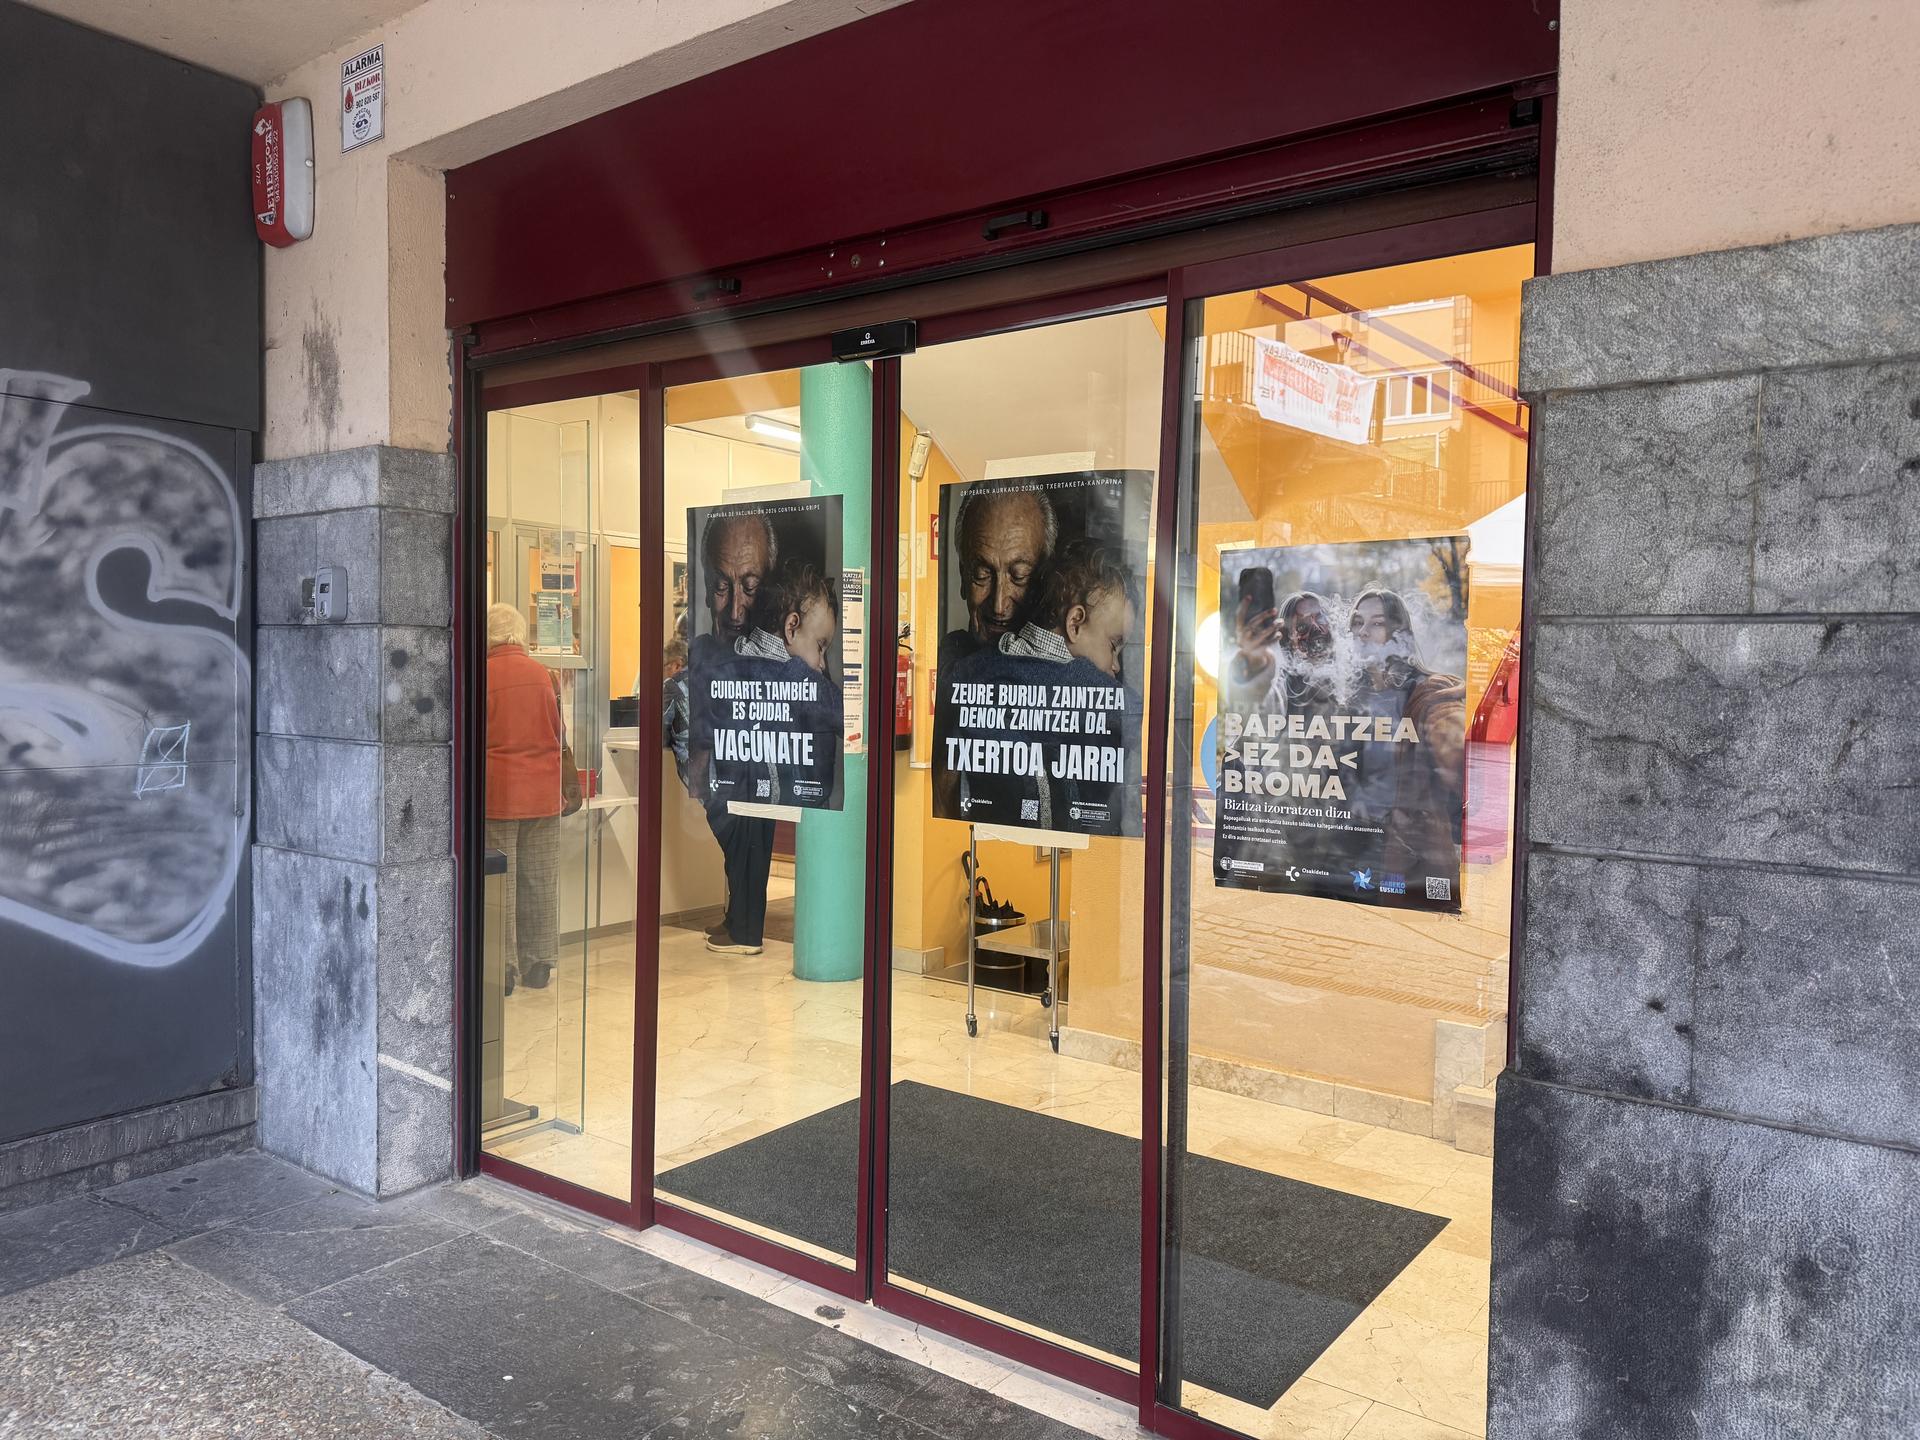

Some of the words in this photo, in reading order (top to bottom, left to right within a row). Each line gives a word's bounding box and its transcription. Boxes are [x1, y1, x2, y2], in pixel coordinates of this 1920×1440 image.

[344, 51, 381, 78] ALARMA
[354, 72, 380, 92] BIZKOR
[992, 486, 1020, 494] AURKAKO
[710, 680, 763, 700] CUIDARTE
[764, 677, 818, 702] TAMBIÉN
[951, 683, 994, 705] ZEURE
[998, 684, 1047, 708] BURUA
[1051, 685, 1125, 711] ZAINTZEA
[732, 701, 746, 720] ES
[748, 702, 794, 722] CUIDAR.
[959, 706, 1007, 730] DENOK
[1009, 708, 1080, 733] ZAINTZEA
[1084, 711, 1112, 735] DA.
[1224, 712, 1420, 743] BAPEATZEA
[713, 722, 814, 766] VACÚNATE
[945, 737, 1045, 777] TXERTOA
[1051, 743, 1125, 784] JARRI
[1224, 769, 1347, 801] BROMA
[1224, 798, 1262, 813] Bizitza
[1263, 801, 1323, 818] izorratzen
[1325, 805, 1352, 820] dizu
[1301, 867, 1330, 876] Osakidetza
